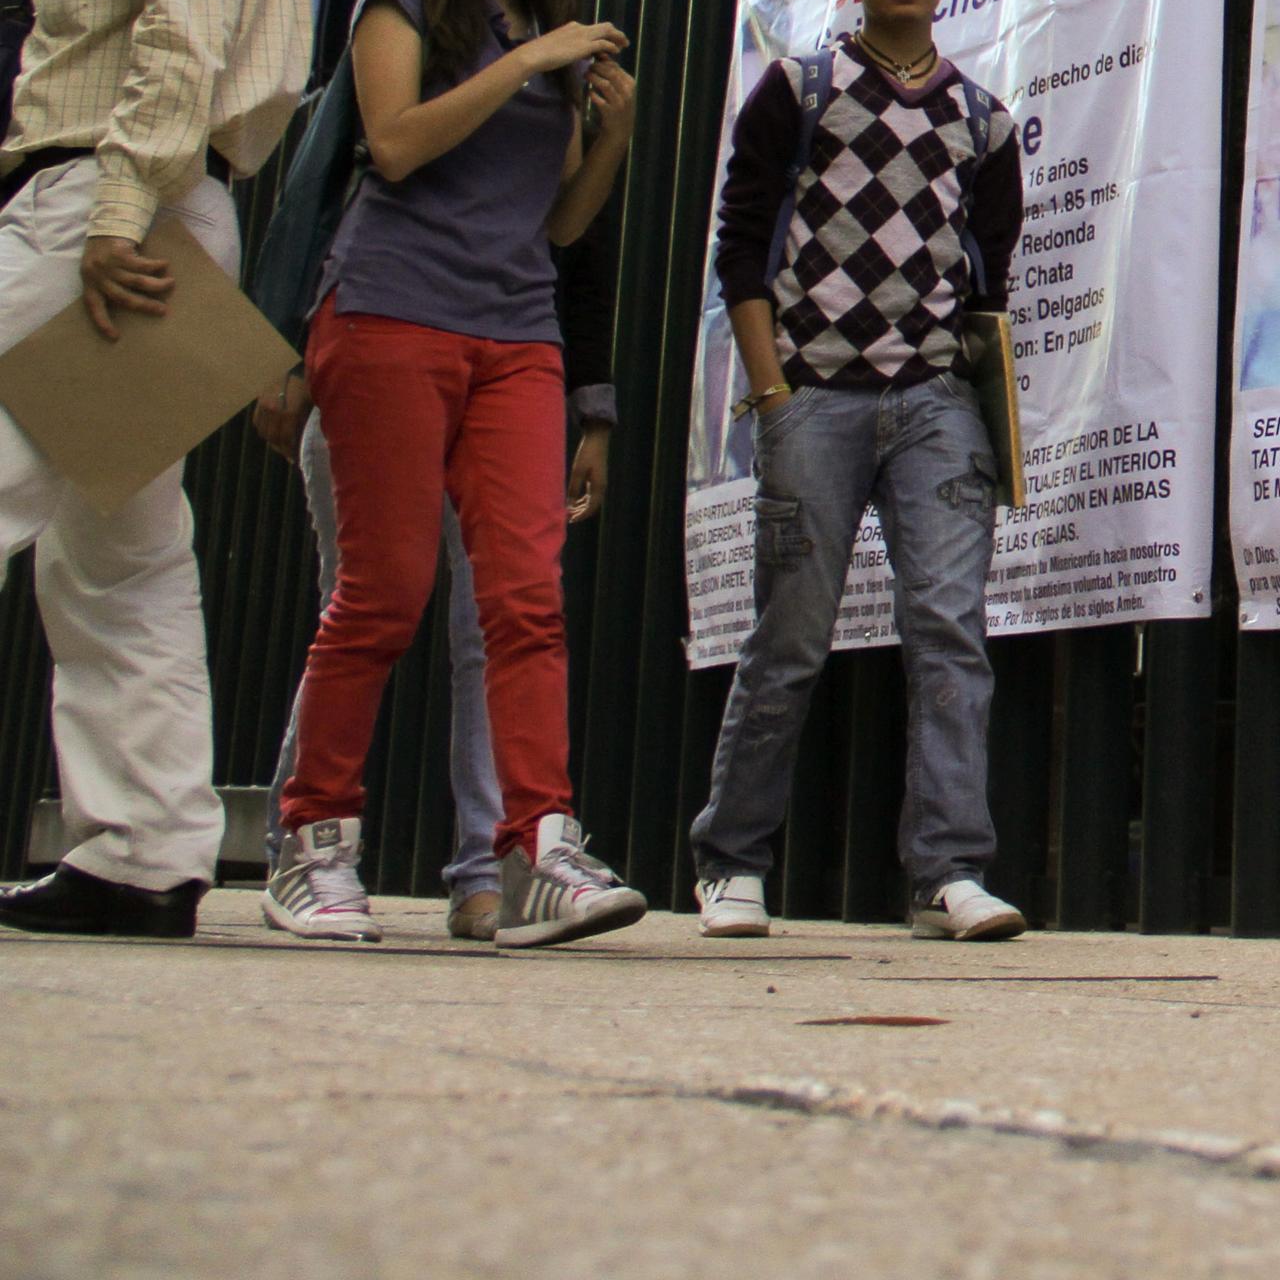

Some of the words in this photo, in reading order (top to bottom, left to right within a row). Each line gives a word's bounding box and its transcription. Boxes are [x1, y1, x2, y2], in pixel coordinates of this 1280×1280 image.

[1028, 61, 1090, 98] derecho
[1095, 54, 1113, 74] de
[1029, 169, 1044, 188] 16
[1048, 157, 1088, 182] años
[1050, 189, 1084, 214] 1.85
[1091, 182, 1120, 206] mts.
[1022, 224, 1095, 257] Redonda
[1026, 263, 1073, 289] Chata
[1038, 288, 1104, 321] Delgados
[1044, 331, 1063, 354] En
[1068, 320, 1102, 353] punta
[1055, 430, 1108, 460] EXTERIOR
[1113, 426, 1132, 445] DE
[1138, 422, 1158, 441] LA
[1080, 462, 1094, 480] EL
[1099, 450, 1176, 476] INTERIOR
[1006, 494, 1085, 525] PERFORACION
[1090, 489, 1108, 508] EN
[1113, 480, 1170, 504] AMBAS
[1130, 542, 1179, 561] nosotros
[1134, 568, 1176, 584] nuestro
